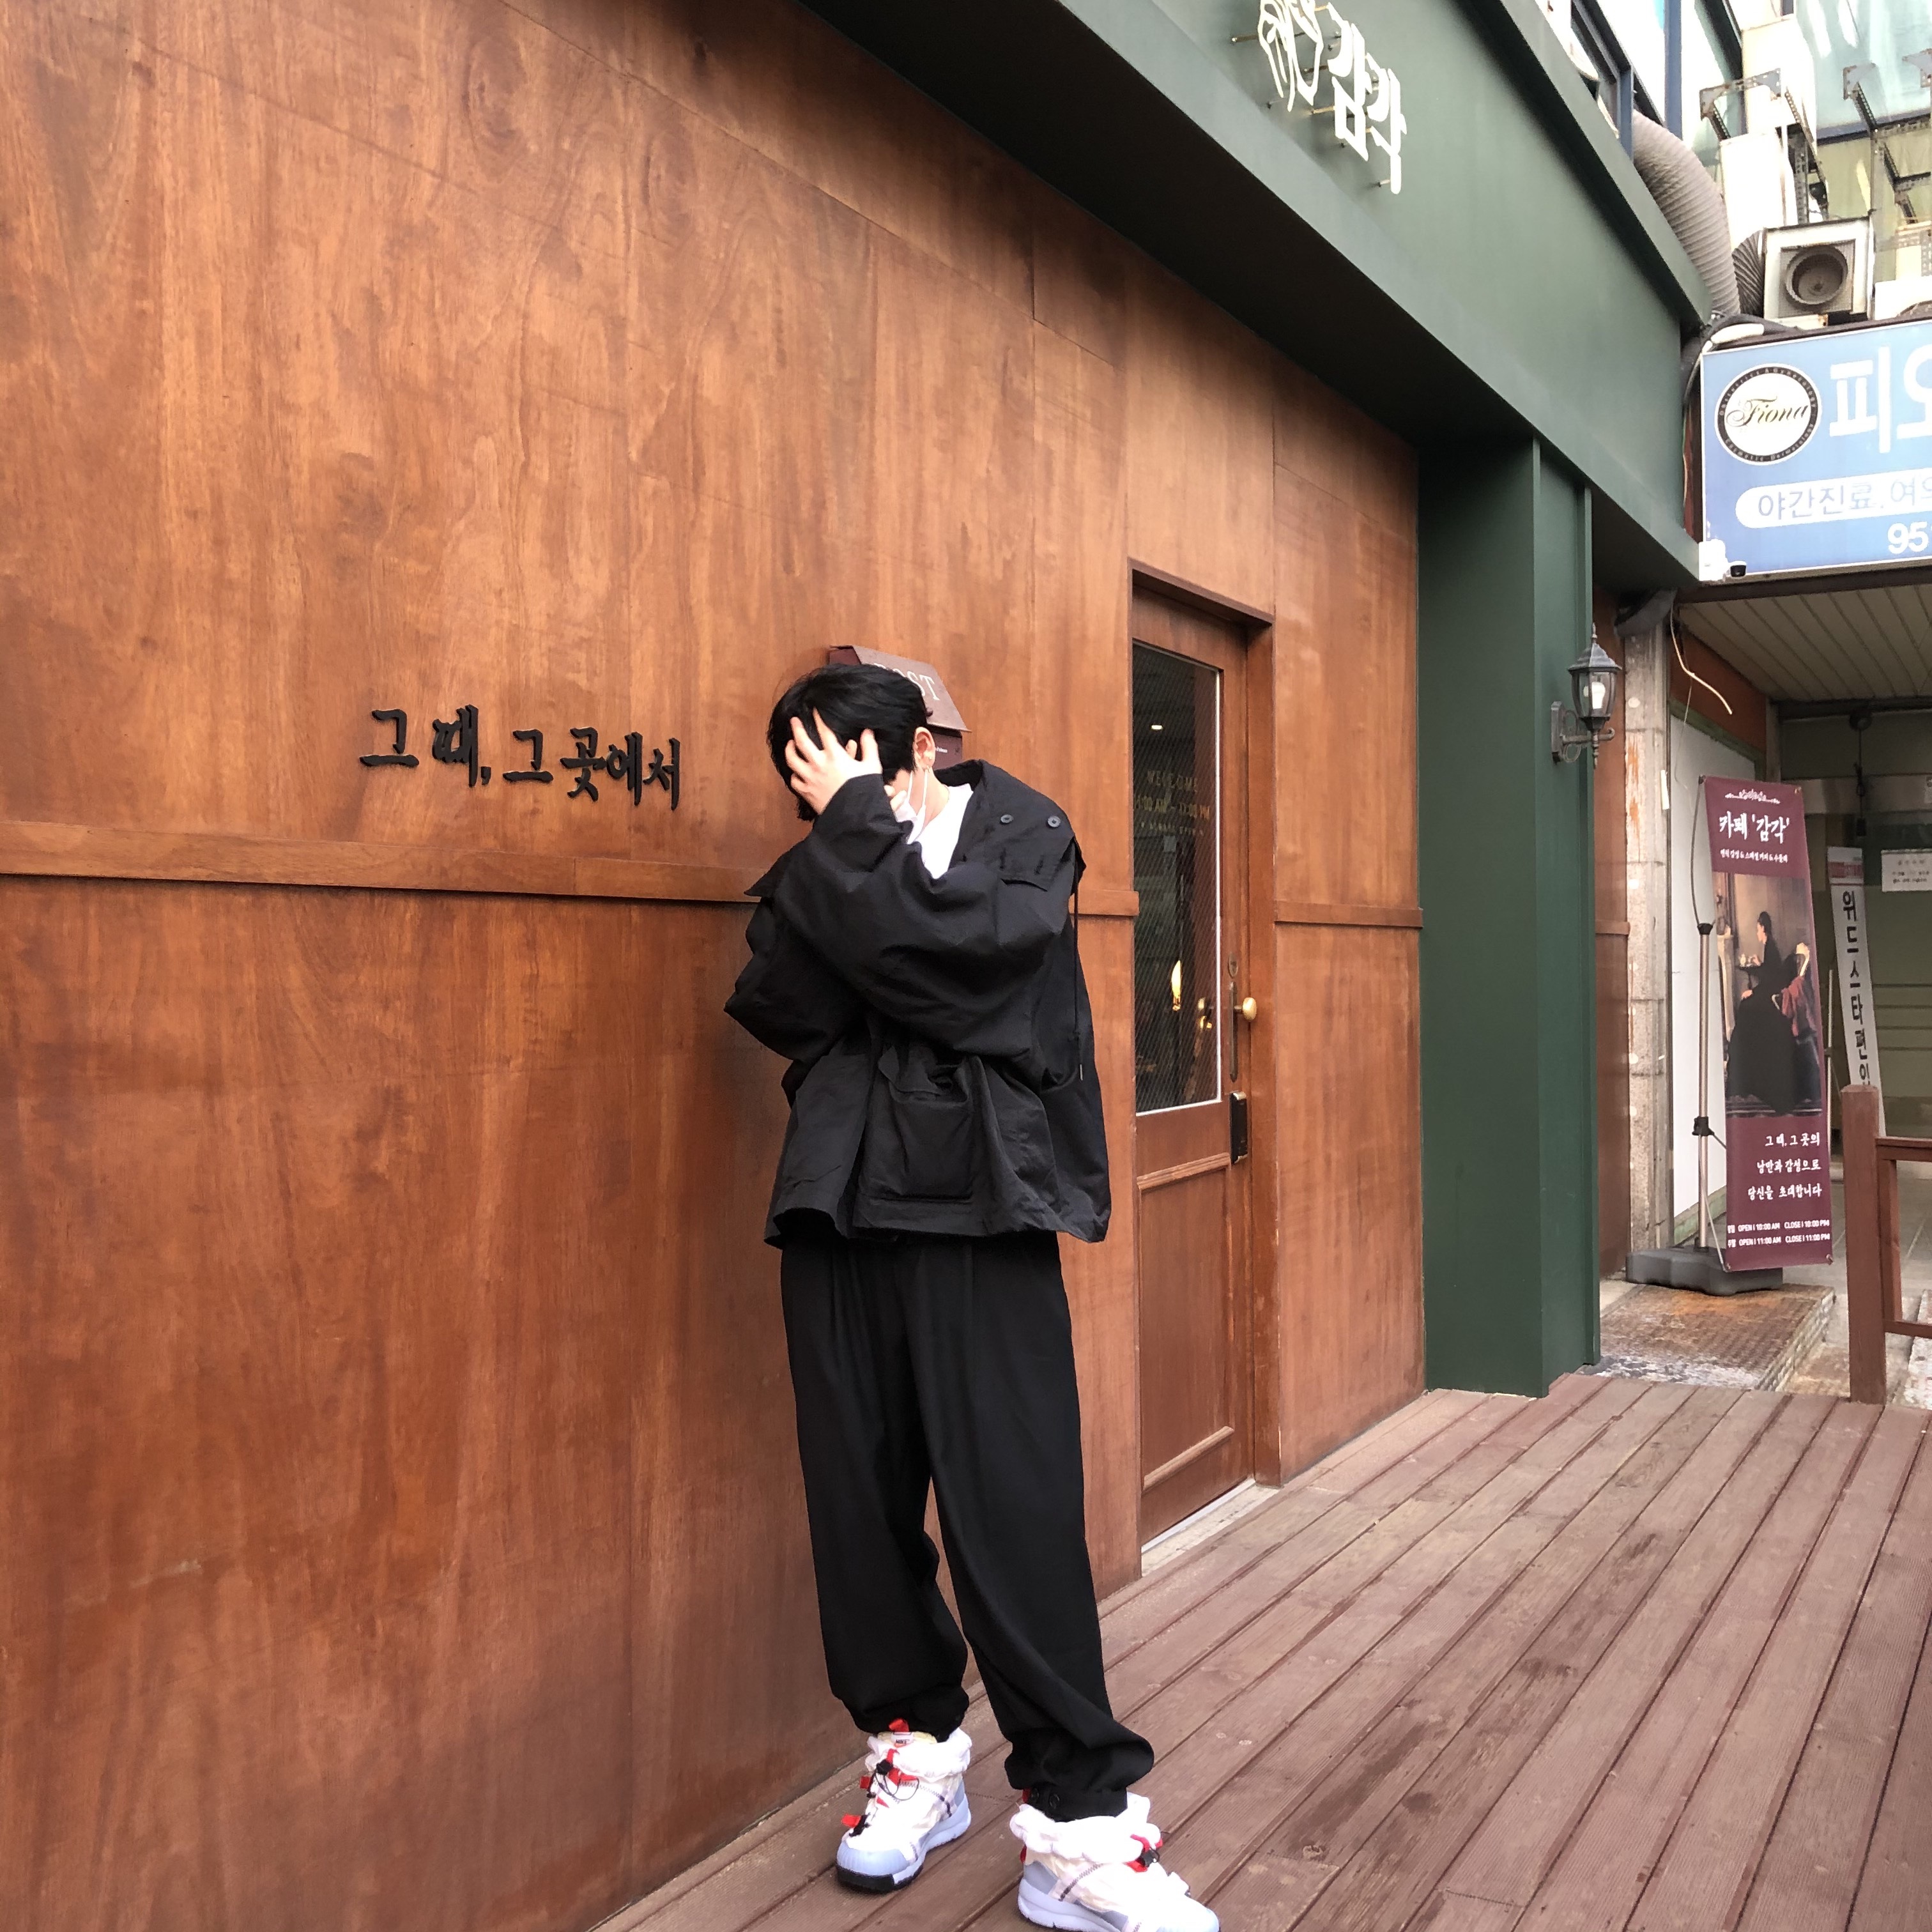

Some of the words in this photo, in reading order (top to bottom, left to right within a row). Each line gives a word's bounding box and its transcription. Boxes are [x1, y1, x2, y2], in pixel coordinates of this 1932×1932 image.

[1327, 1, 1407, 195] 감각
[1726, 395, 1809, 427] Fiona
[1887, 520, 1932, 555] 95
[873, 663, 940, 701] ST
[1719, 811, 1747, 840] 카페
[1756, 1159, 1782, 1174] 낭만과
[1784, 1158, 1821, 1173] 감성으로
[1748, 1185, 1774, 1200] 당신을
[1779, 1183, 1822, 1199] 초대합니다
[1738, 1223, 1752, 1232] OPEN
[1784, 1221, 1801, 1229] CLOSE
[1738, 1238, 1753, 1246] OPEN
[1785, 1235, 1802, 1243] CLOSE
